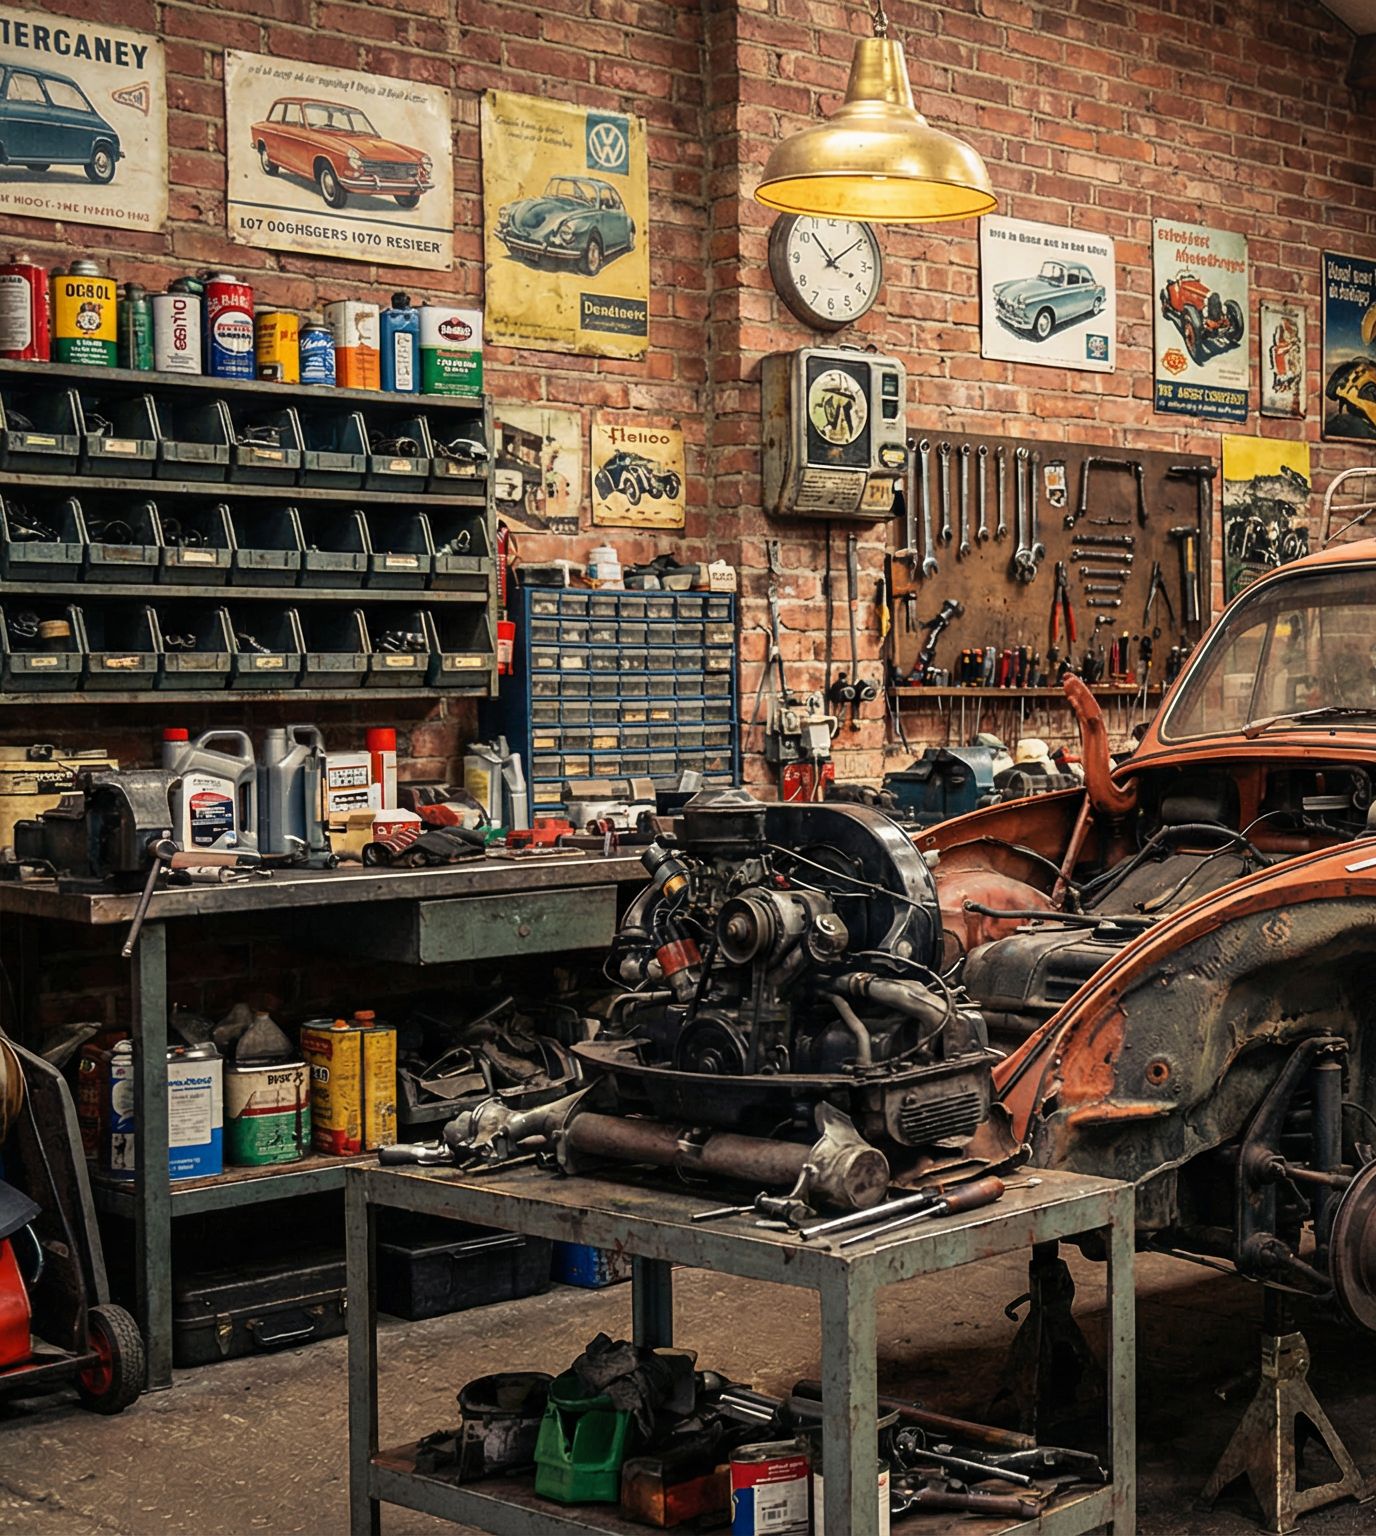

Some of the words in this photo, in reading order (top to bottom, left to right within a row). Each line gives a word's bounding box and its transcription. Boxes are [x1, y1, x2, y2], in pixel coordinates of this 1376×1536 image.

[792, 252, 800, 263] 9
[799, 275, 807, 287] 8
[811, 290, 819, 305] 7
[827, 298, 835, 310] 6
